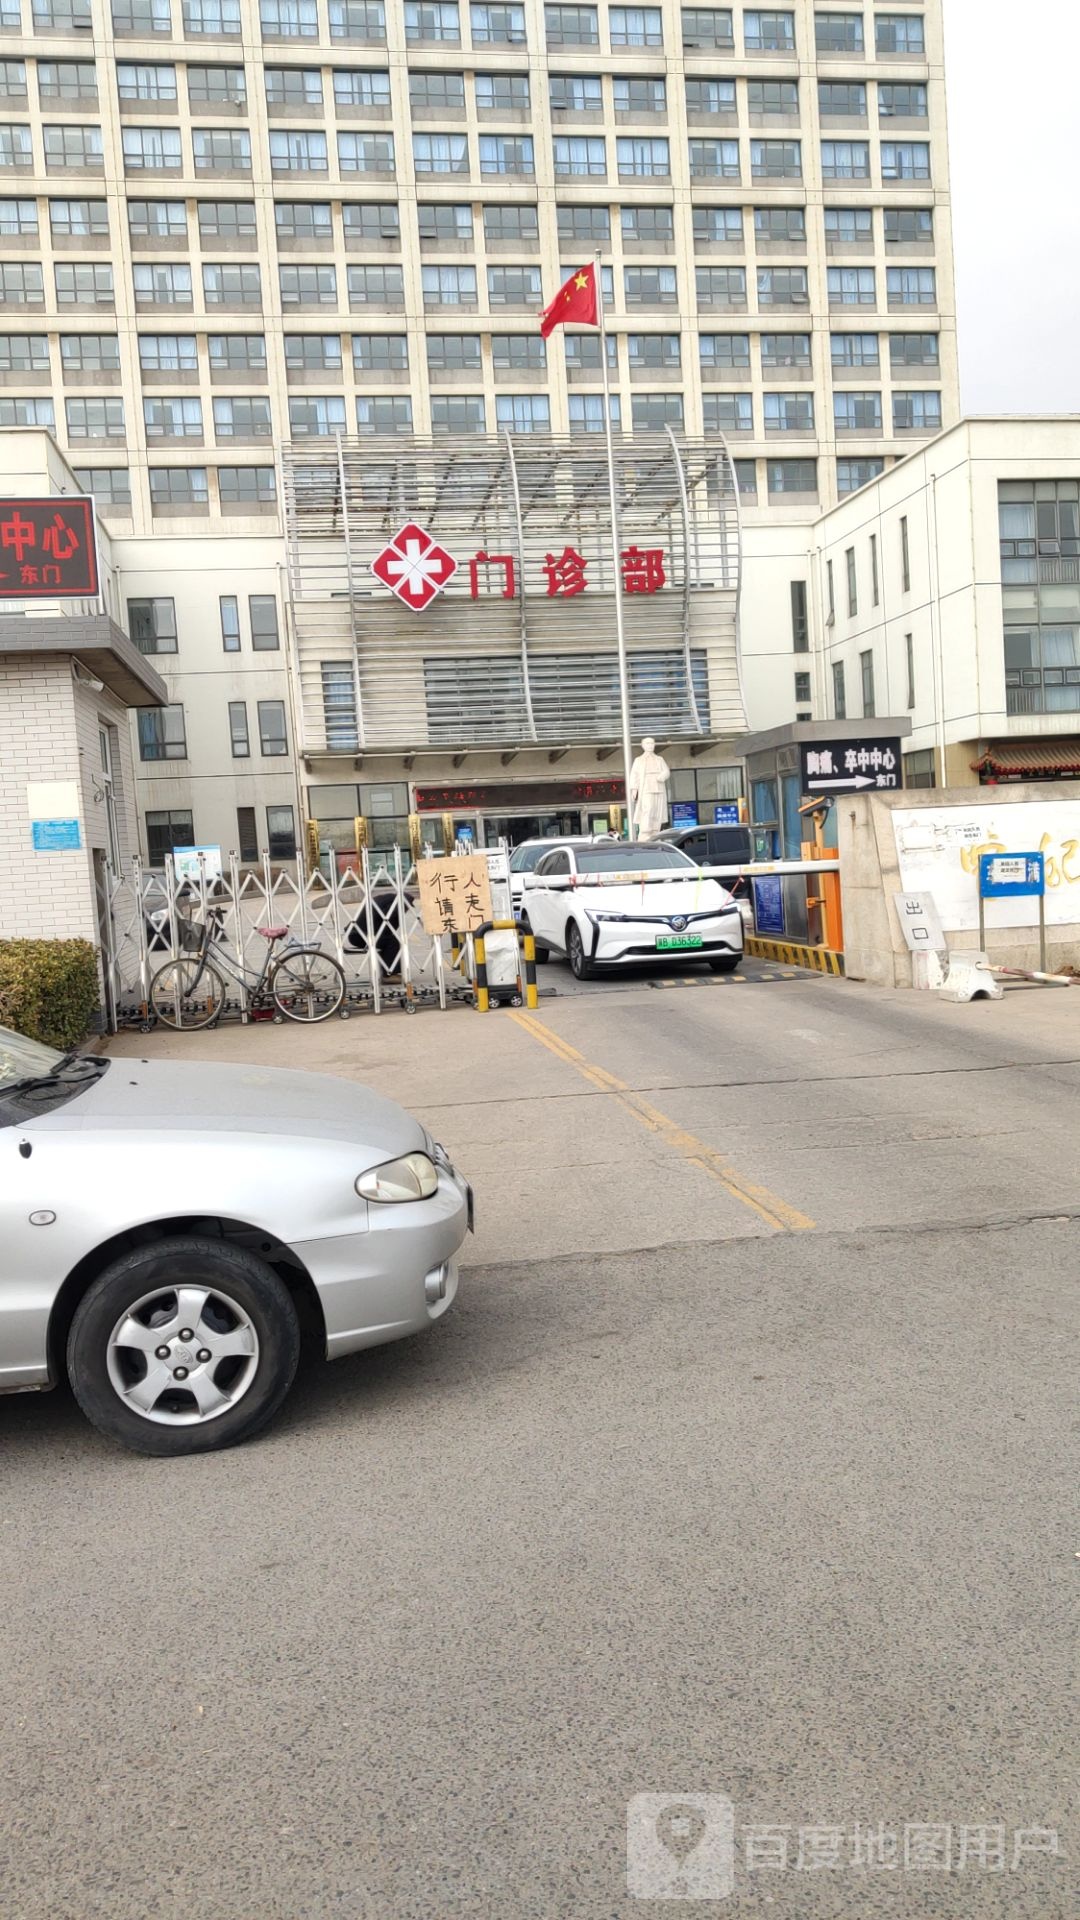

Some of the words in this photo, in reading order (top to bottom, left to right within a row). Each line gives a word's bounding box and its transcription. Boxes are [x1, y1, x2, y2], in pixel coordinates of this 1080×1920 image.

[1, 511, 79, 561] 中心
[20, 564, 62, 584] 东门
[469, 545, 666, 600] 门诊部
[876, 774, 896, 787] 东门
[430, 872, 481, 894] 行人
[442, 914, 484, 933] 东门
[906, 901, 929, 940] 出口
